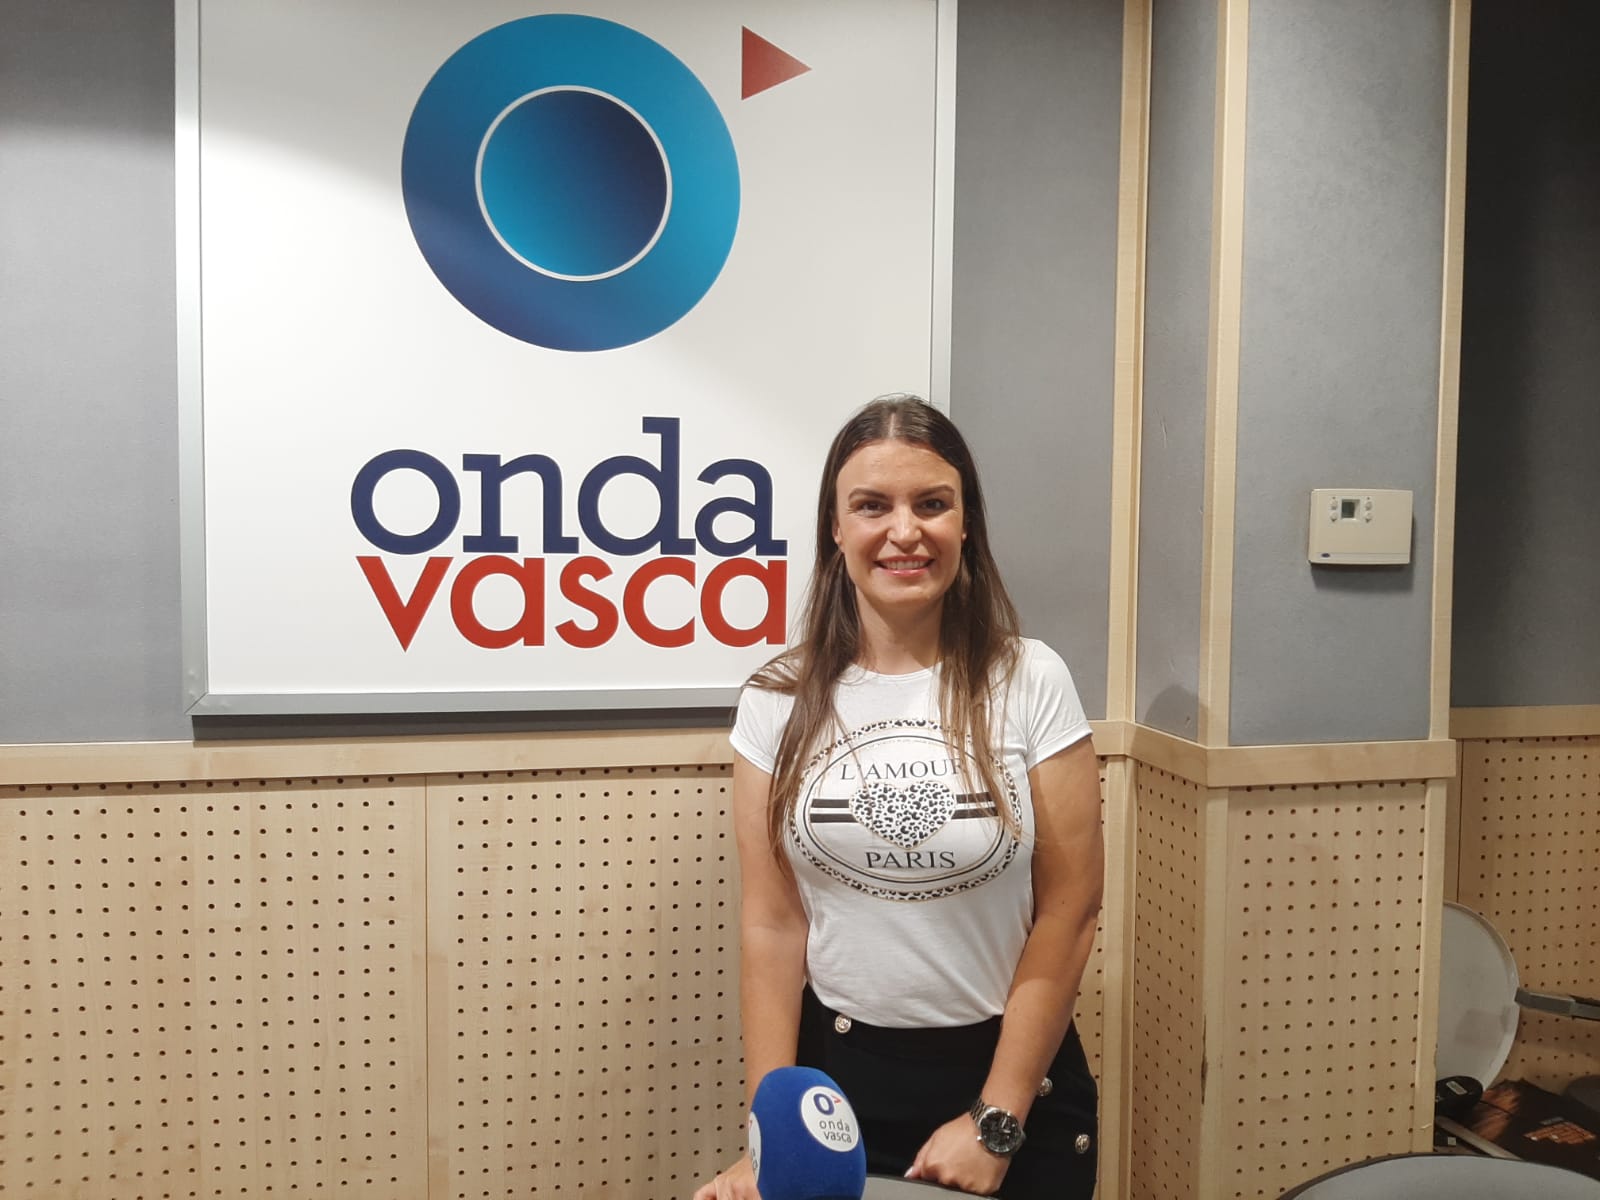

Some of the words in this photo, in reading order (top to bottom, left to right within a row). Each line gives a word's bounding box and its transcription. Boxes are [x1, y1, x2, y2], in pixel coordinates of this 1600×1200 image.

[350, 416, 788, 557] onda
[355, 555, 788, 652] vasca
[865, 851, 957, 869] PARIS
[819, 1119, 850, 1132] onda
[823, 1131, 852, 1143] vasca
